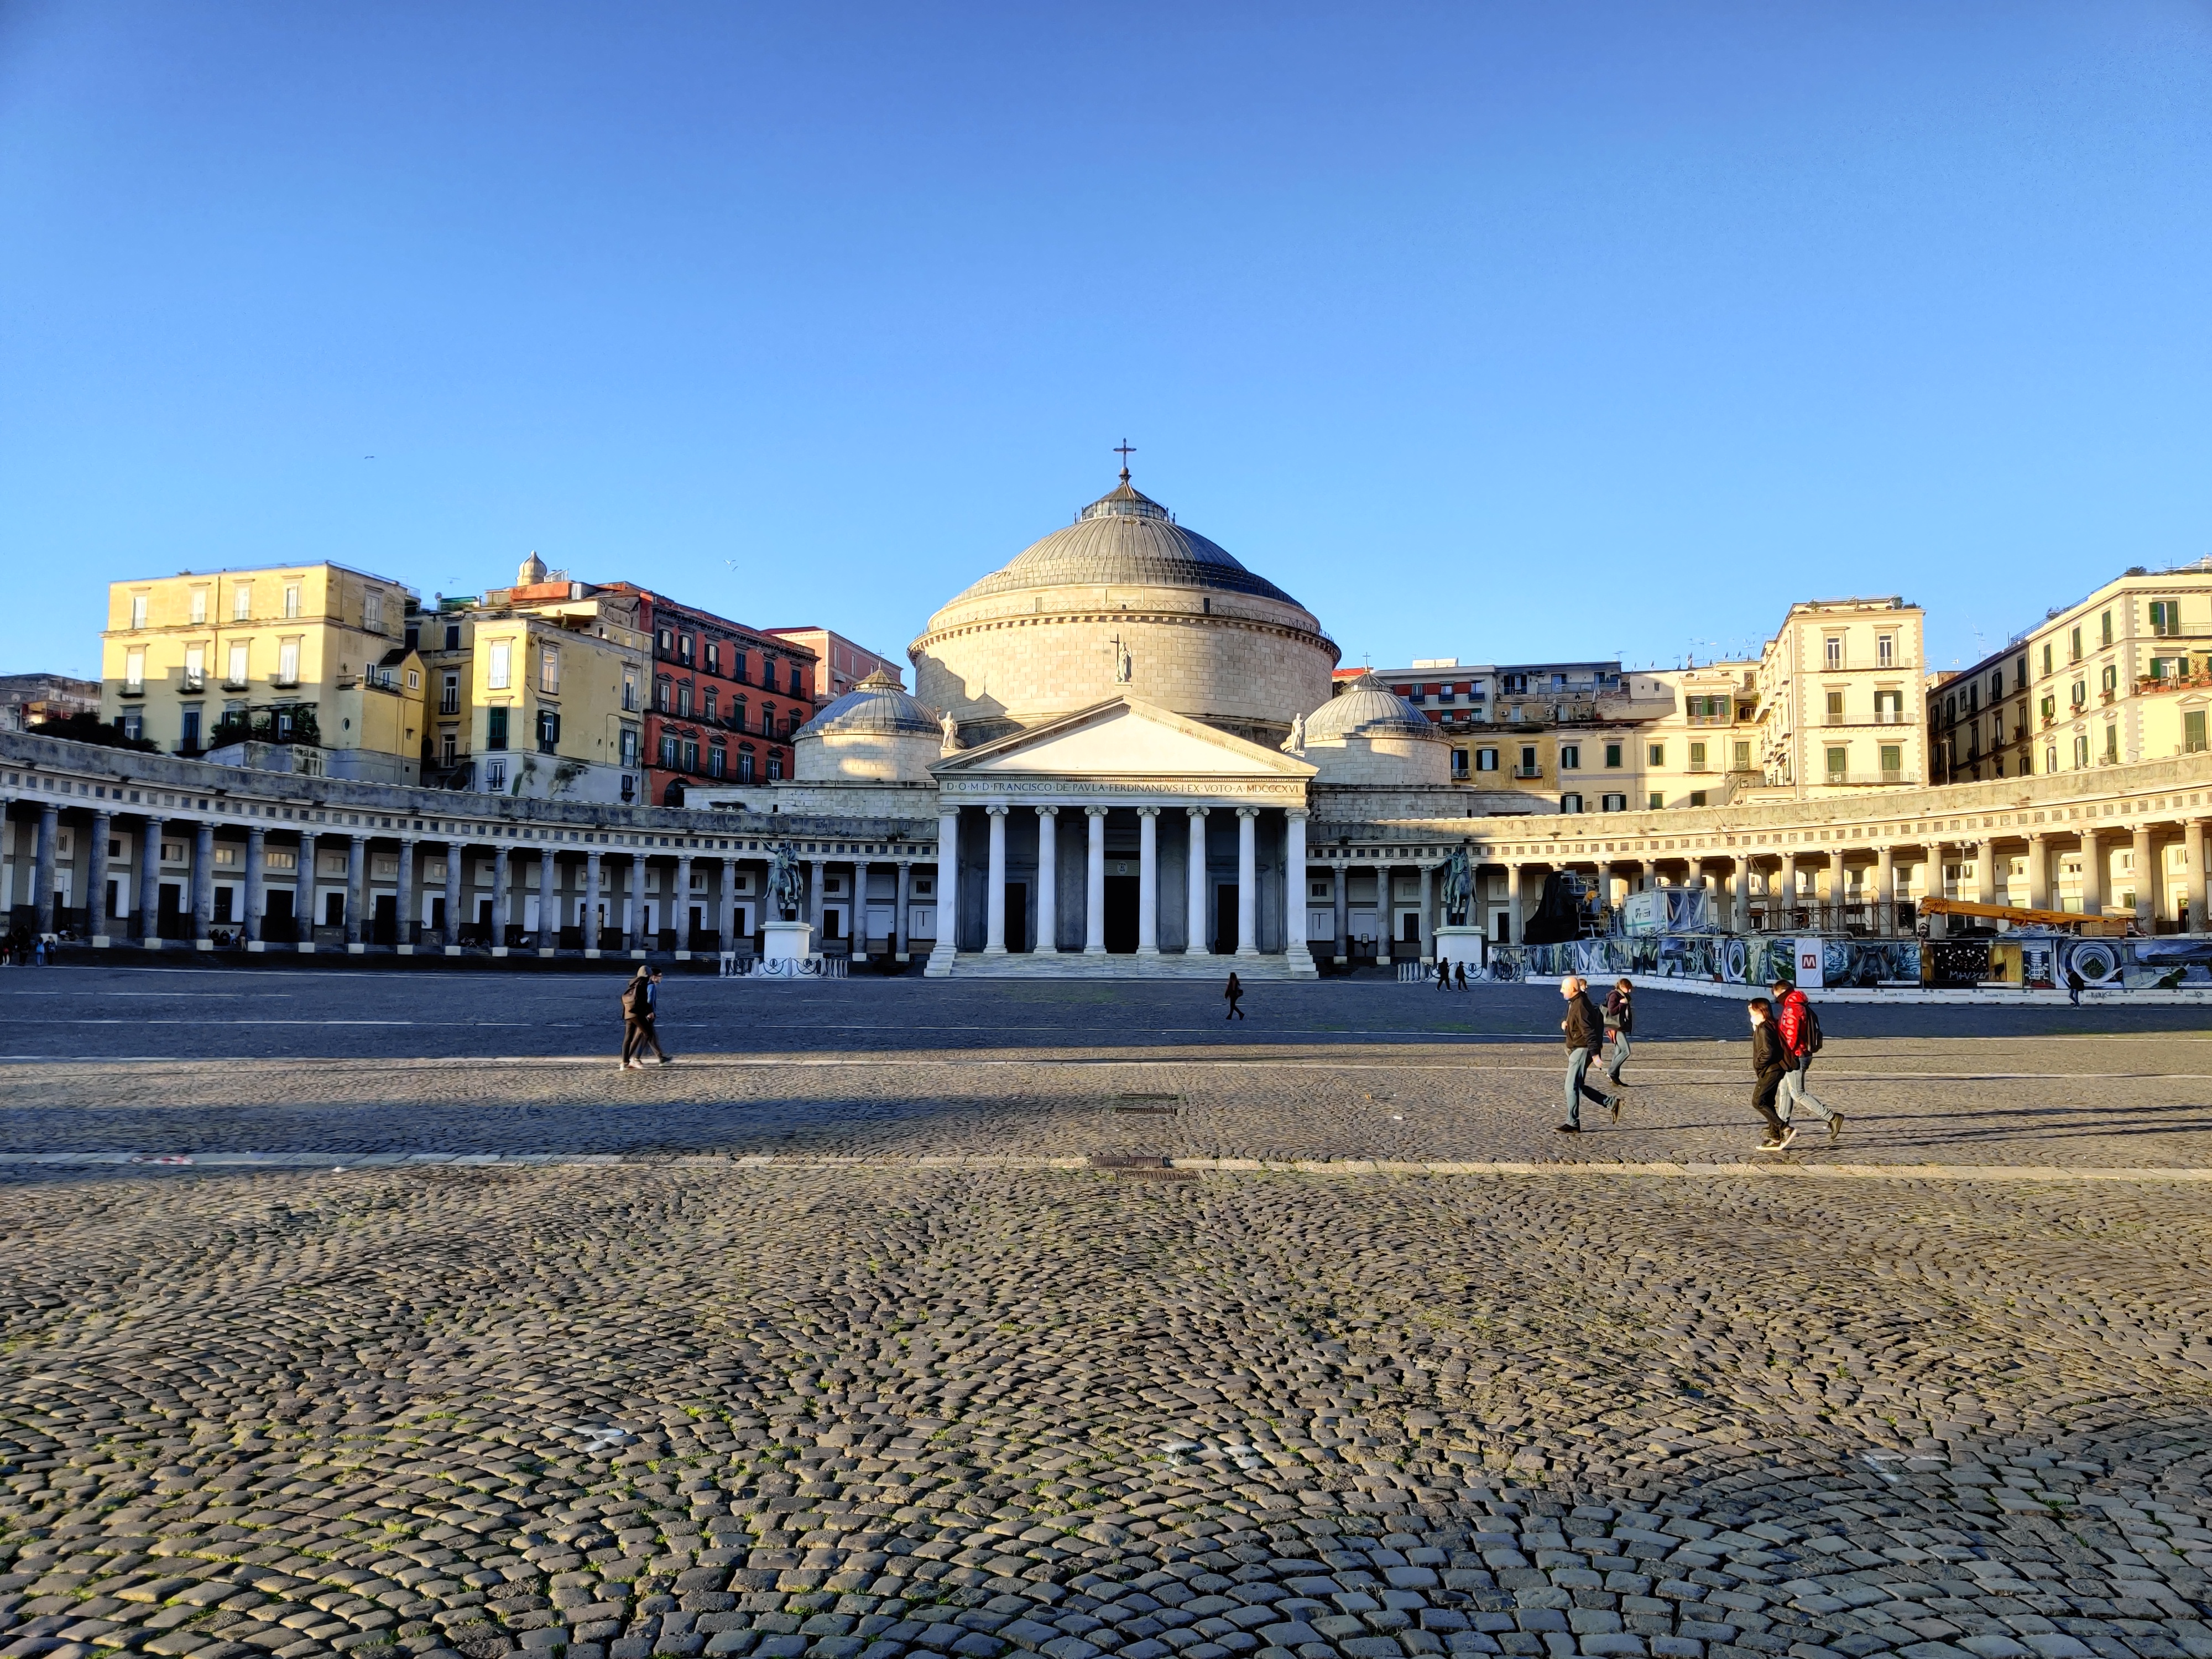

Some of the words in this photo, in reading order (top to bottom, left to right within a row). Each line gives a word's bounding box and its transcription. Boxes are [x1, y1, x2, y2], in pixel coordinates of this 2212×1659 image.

[994, 783, 1052, 791] FRANCISCO
[1109, 784, 1177, 792] FERDINANDVS
[1204, 784, 1232, 792] VOTO
[1246, 785, 1298, 793] MDCCCXVI
[1803, 957, 1815, 967] M
